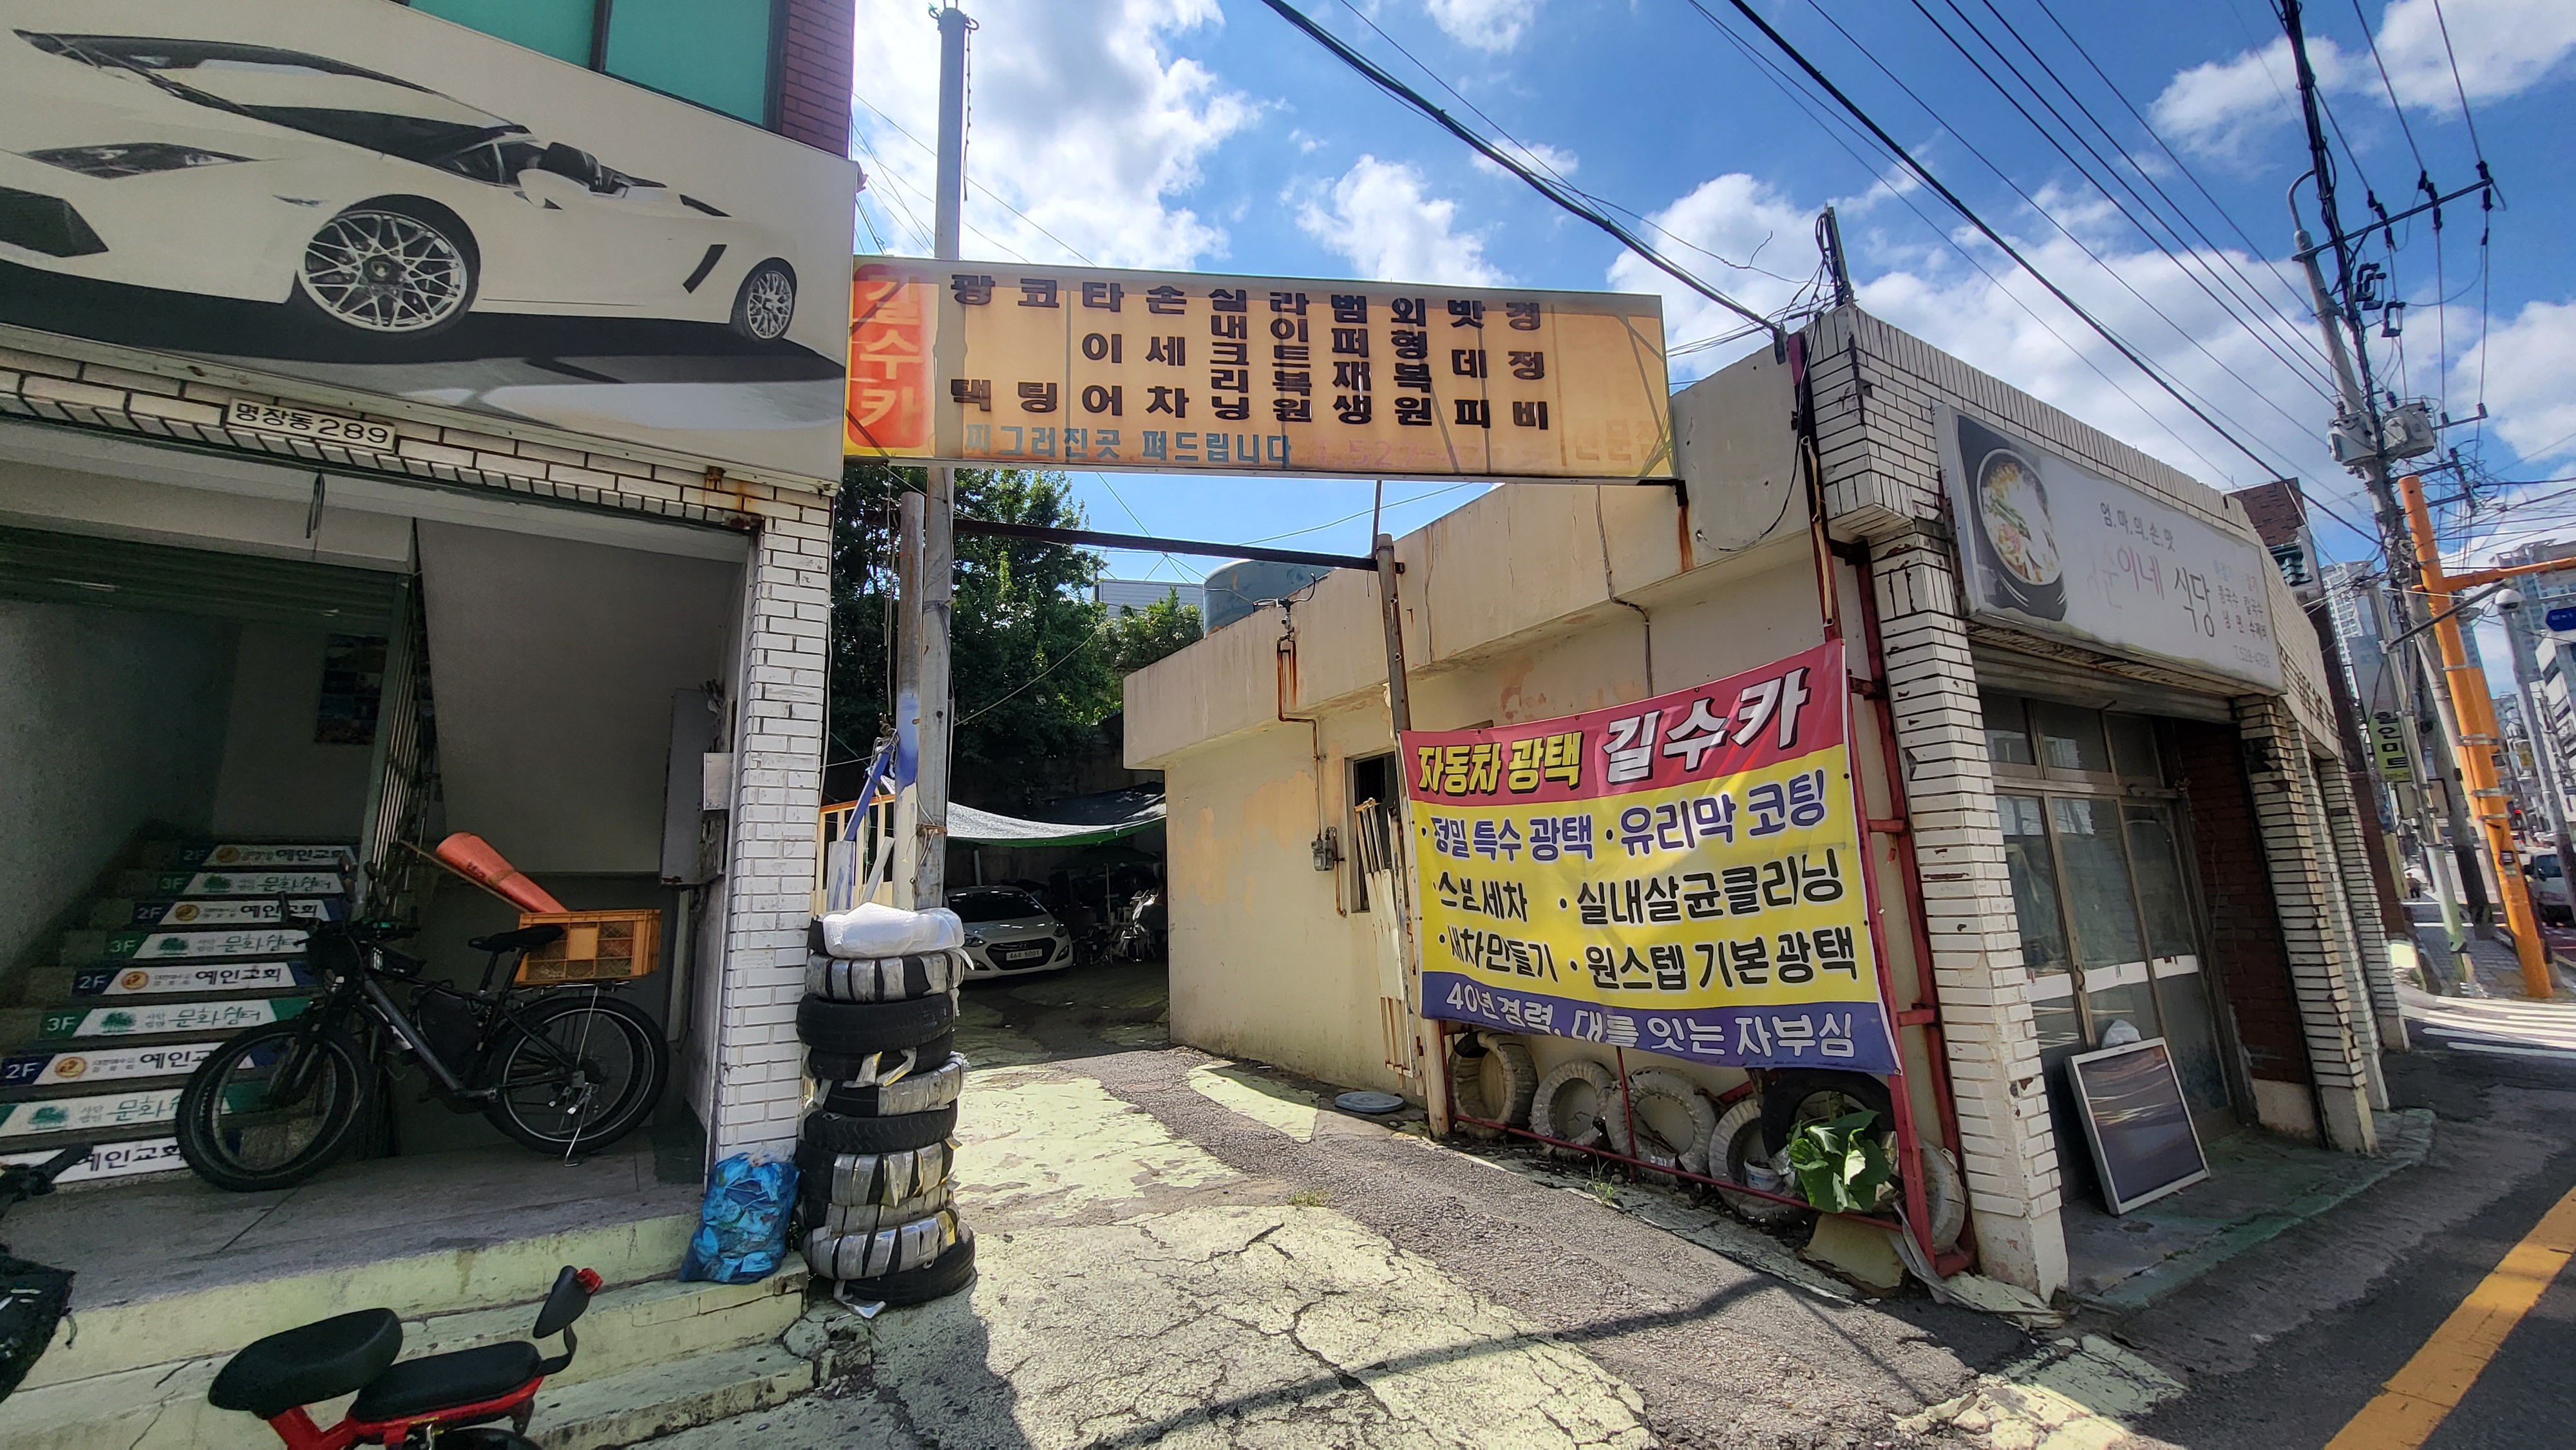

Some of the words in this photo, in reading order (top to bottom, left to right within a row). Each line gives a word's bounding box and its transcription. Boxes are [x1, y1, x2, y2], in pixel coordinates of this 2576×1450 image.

[858, 276, 923, 438] 길수카
[1018, 278, 1060, 413] 코팅
[1082, 281, 1124, 417] 타이어
[1145, 285, 1190, 419] 손세차
[1208, 288, 1250, 421] 실내크리닝
[1269, 291, 1312, 423] 라이트복원
[1331, 294, 1373, 425] 범퍼재생
[1390, 297, 1432, 426] 외형복원
[1506, 301, 1549, 431] 경정비
[2174, 567, 2215, 638] 식당
[1417, 742, 1502, 796] 자동차
[1508, 730, 1584, 794] 광택
[1604, 666, 1811, 784] 길수카
[1430, 817, 1470, 858] 정밀
[1473, 818, 1522, 862] 특수
[1529, 814, 1593, 862] 광택
[1620, 793, 1737, 857] 유리막
[1748, 769, 1825, 837] 코팅
[137, 907, 163, 919] 2F
[160, 878, 185, 890] 3F
[1577, 847, 1844, 925] 실내살균클리닝
[78, 974, 108, 990] 2F
[109, 939, 137, 953] 3F
[195, 967, 281, 985] 예인교회
[1447, 925, 1558, 983] 새차만들기
[1585, 944, 1687, 990] 원스텝
[46, 1017, 76, 1031] 3F
[1446, 981, 1501, 1021] 40년
[1571, 1009, 1640, 1048] 대를
[1647, 1017, 1725, 1055] 잇는
[1734, 1012, 1855, 1057] 자부심
[6, 1062, 39, 1080] 2F
[140, 1050, 213, 1069] 예인교
[106, 1096, 182, 1122] 문화
